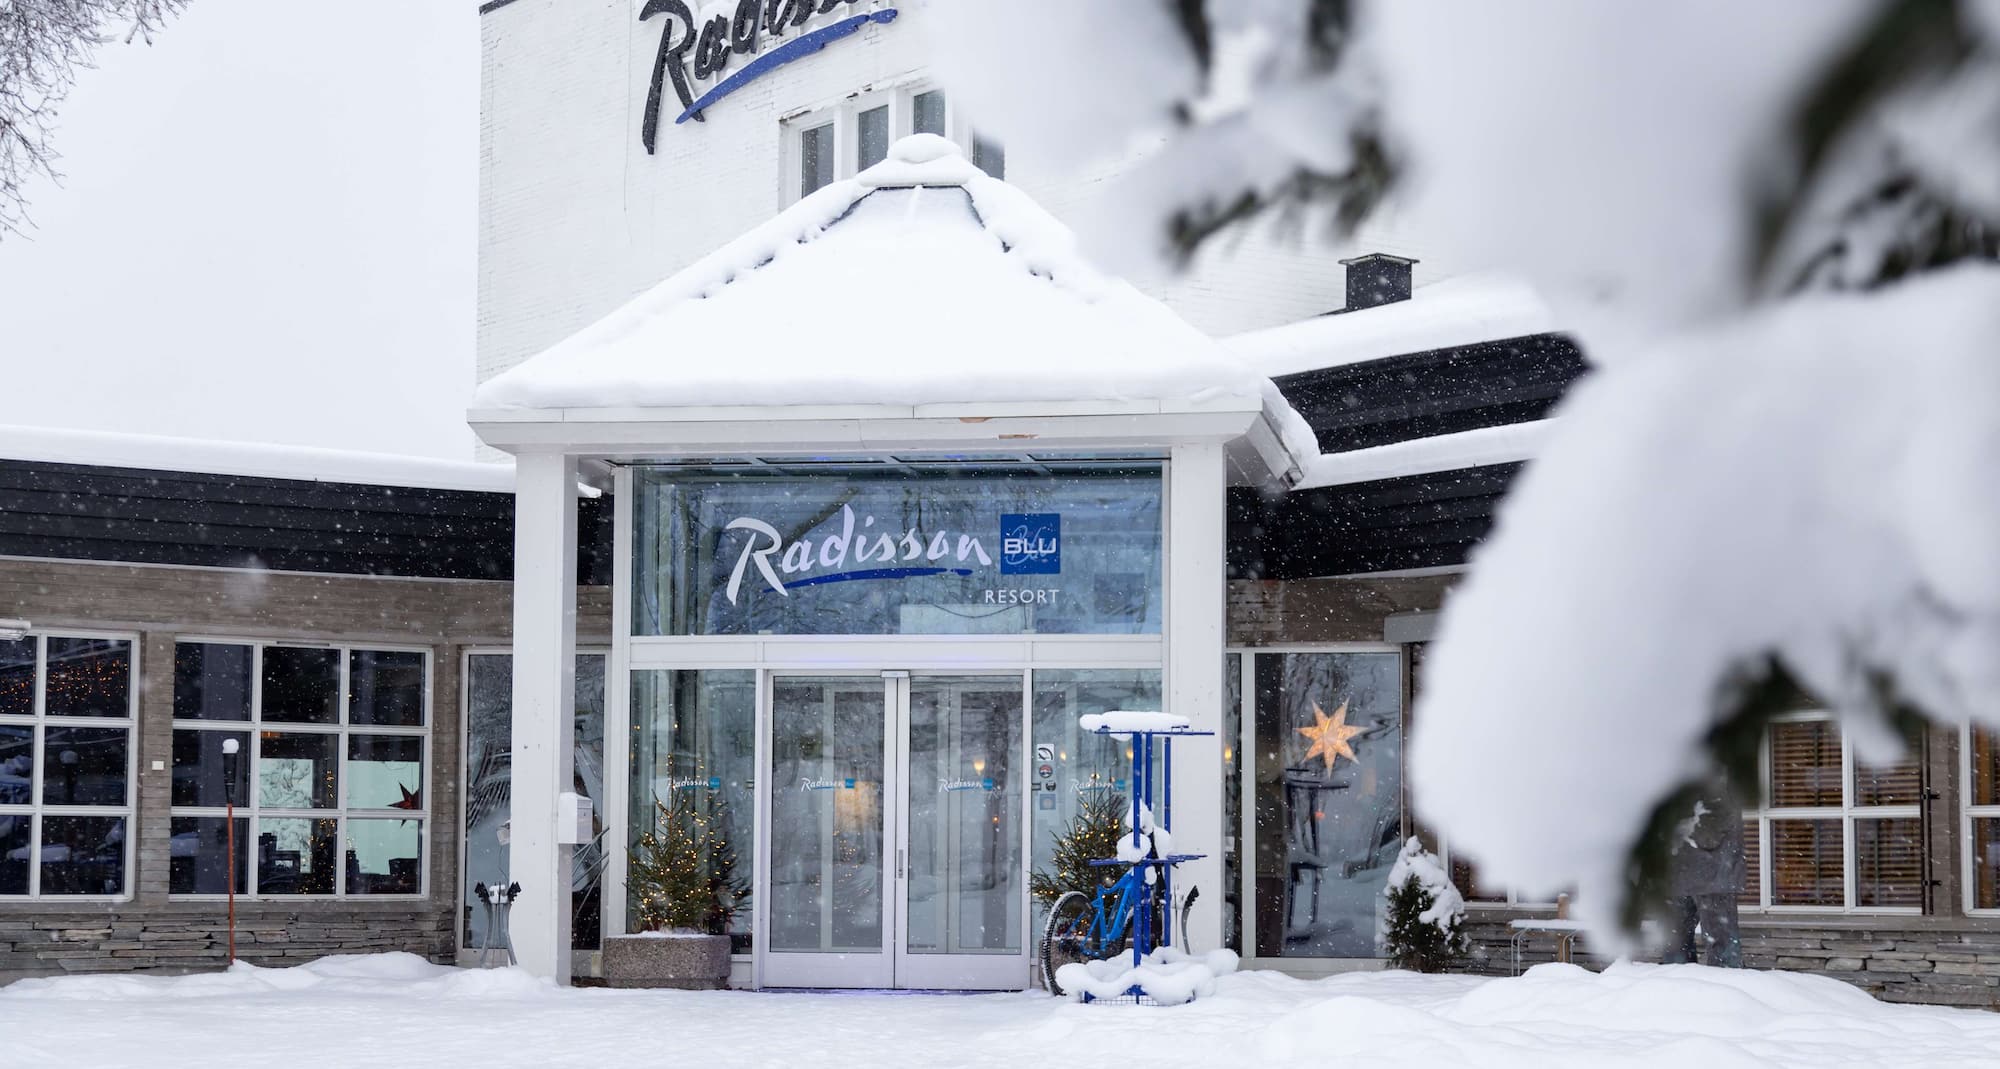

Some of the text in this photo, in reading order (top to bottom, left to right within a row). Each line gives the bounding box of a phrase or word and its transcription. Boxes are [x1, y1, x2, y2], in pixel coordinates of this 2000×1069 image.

[726, 503, 1057, 605] Radisson BLU
[985, 589, 1059, 603] RESORT
[801, 776, 844, 792] Radisson
[938, 777, 982, 792] Radisson
